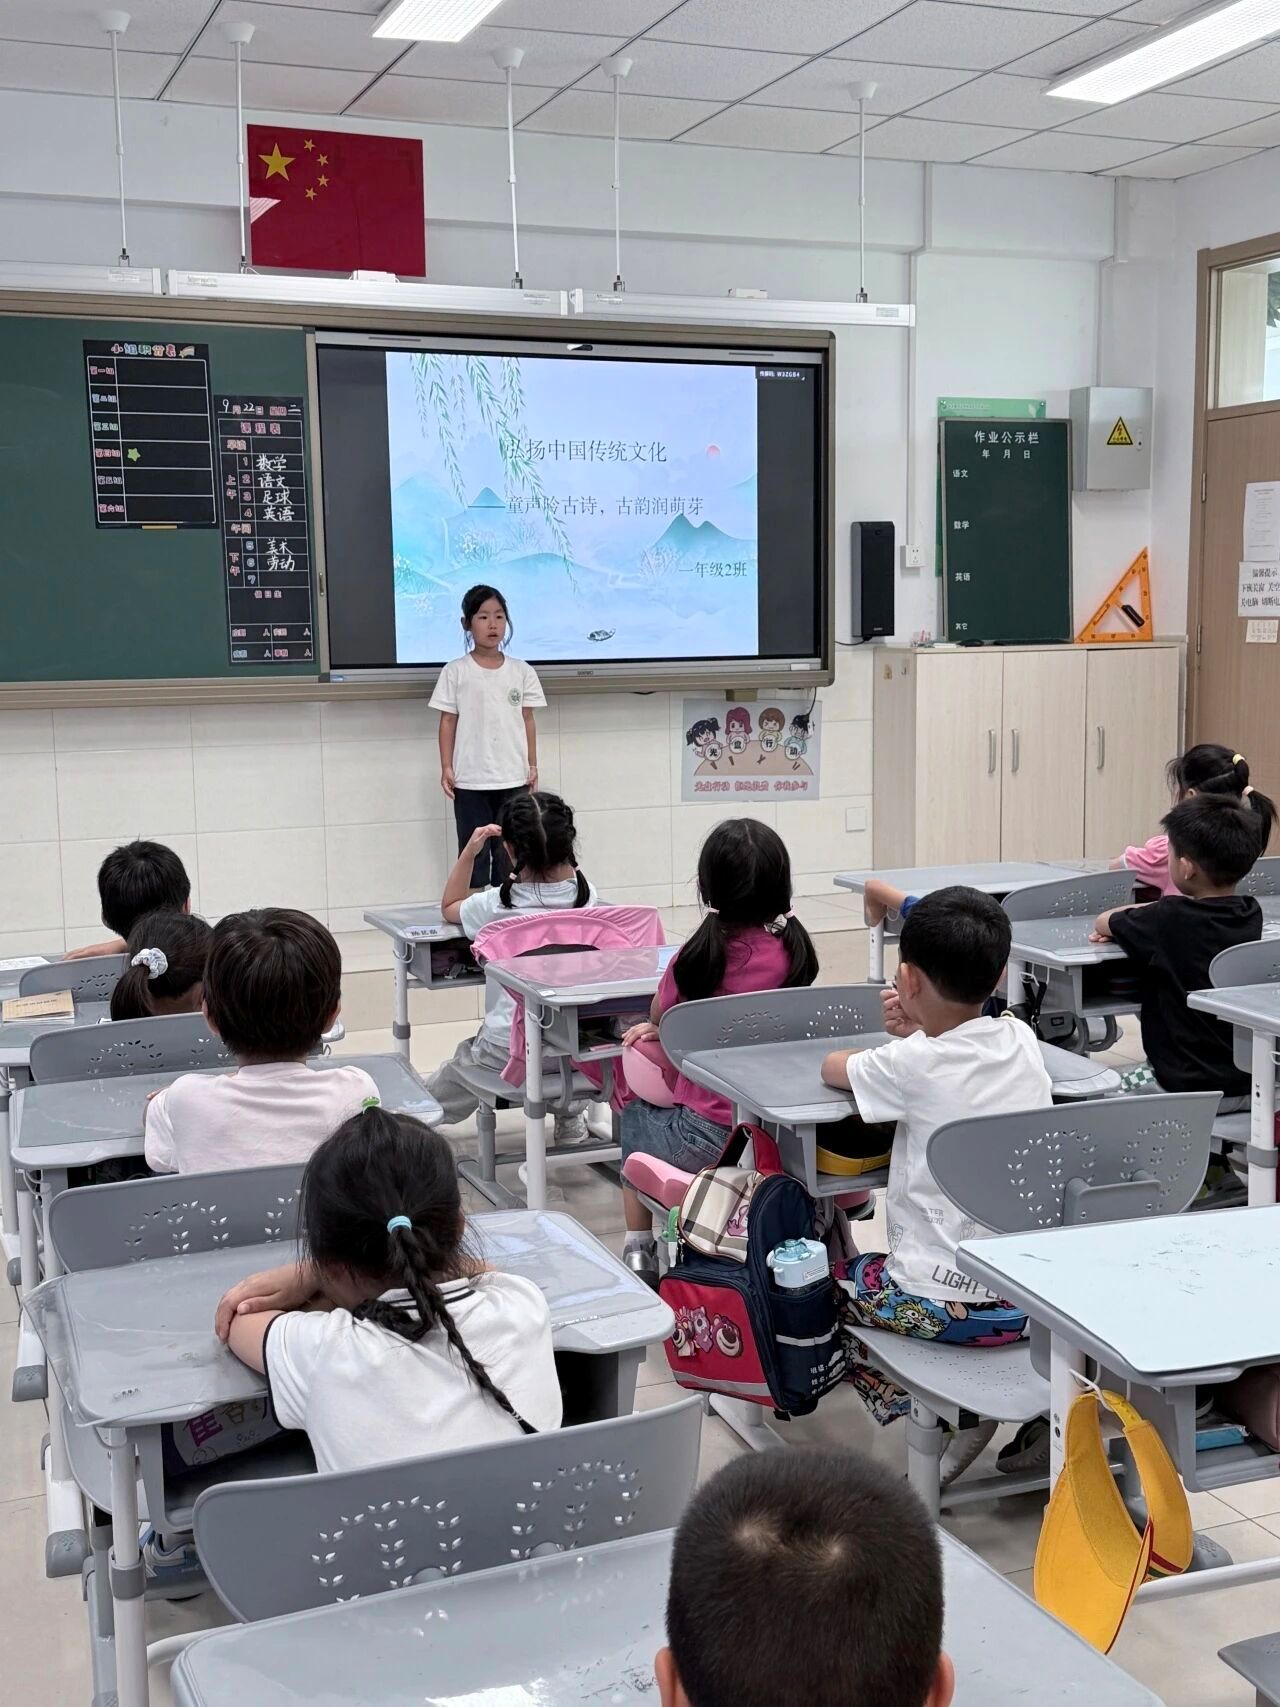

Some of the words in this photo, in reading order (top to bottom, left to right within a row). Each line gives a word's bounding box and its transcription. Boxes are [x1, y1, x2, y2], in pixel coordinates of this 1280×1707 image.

[111, 343, 176, 357] 小组积分表
[241, 422, 281, 434] 课程表
[974, 430, 1040, 444] 作业公示栏
[506, 439, 667, 462] 弘扬中国传统文化
[982, 449, 990, 459] 年
[1003, 449, 1010, 459] 月
[1024, 450, 1030, 459] 日
[256, 453, 287, 472] 数学
[952, 469, 968, 478] 语文
[242, 474, 250, 484] 2
[258, 473, 288, 489] 语文
[243, 492, 252, 501] 3
[262, 488, 293, 505] 足球
[244, 508, 252, 518] 4
[262, 506, 295, 522] 英语
[954, 521, 970, 530] 数学
[265, 538, 294, 556] 美术
[266, 554, 296, 572] 劳动
[679, 560, 748, 578] 一年级2班
[248, 574, 256, 584] 7
[955, 573, 970, 582] 英语
[262, 628, 270, 636] 人
[304, 627, 311, 636] 人
[264, 650, 272, 658] 人
[304, 648, 312, 656] 人
